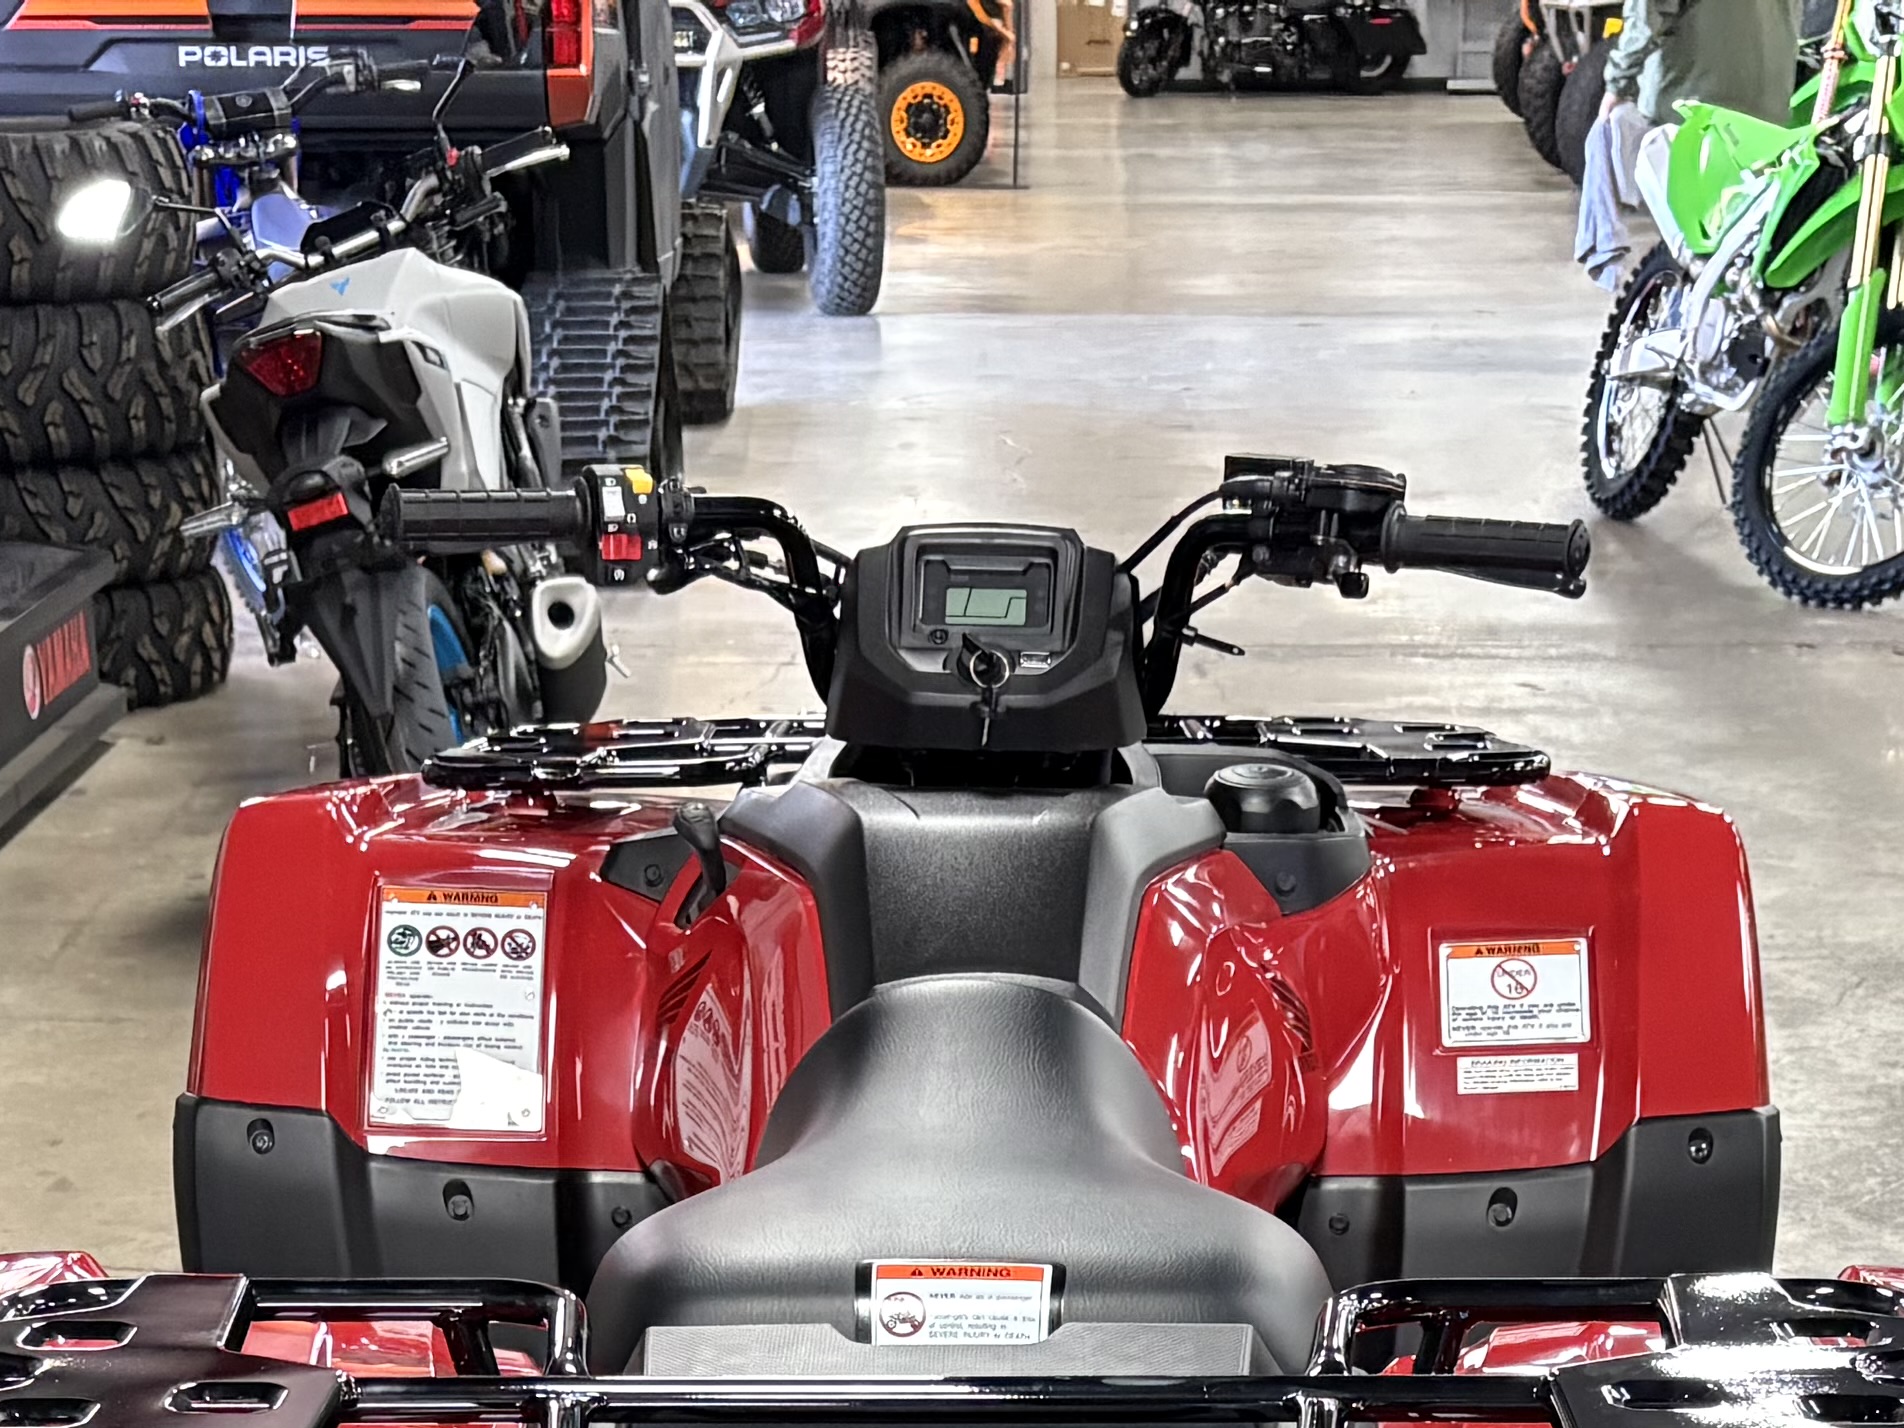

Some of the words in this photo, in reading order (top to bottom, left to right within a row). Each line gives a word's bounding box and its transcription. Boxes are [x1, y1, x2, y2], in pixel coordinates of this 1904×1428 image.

[178, 45, 331, 67] POLARIS
[442, 892, 499, 904] WARNING
[1485, 943, 1541, 955] WARNING
[930, 1266, 1011, 1278] WARNING
